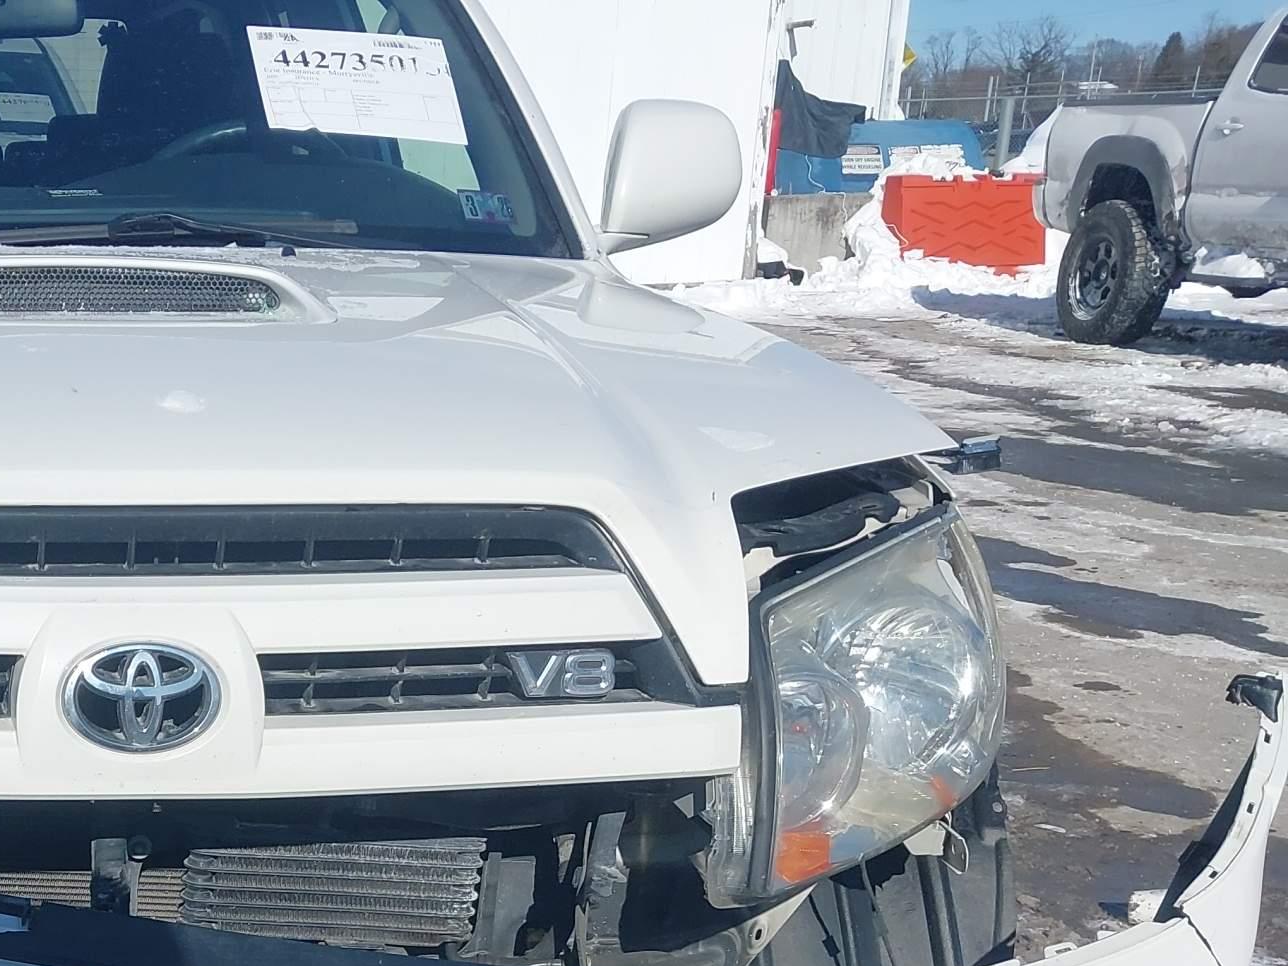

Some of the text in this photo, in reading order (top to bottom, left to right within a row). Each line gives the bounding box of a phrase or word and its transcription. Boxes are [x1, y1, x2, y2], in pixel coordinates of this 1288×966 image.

[273, 48, 418, 74] 44273501
[465, 194, 479, 217] 3
[506, 648, 615, 698] V8
